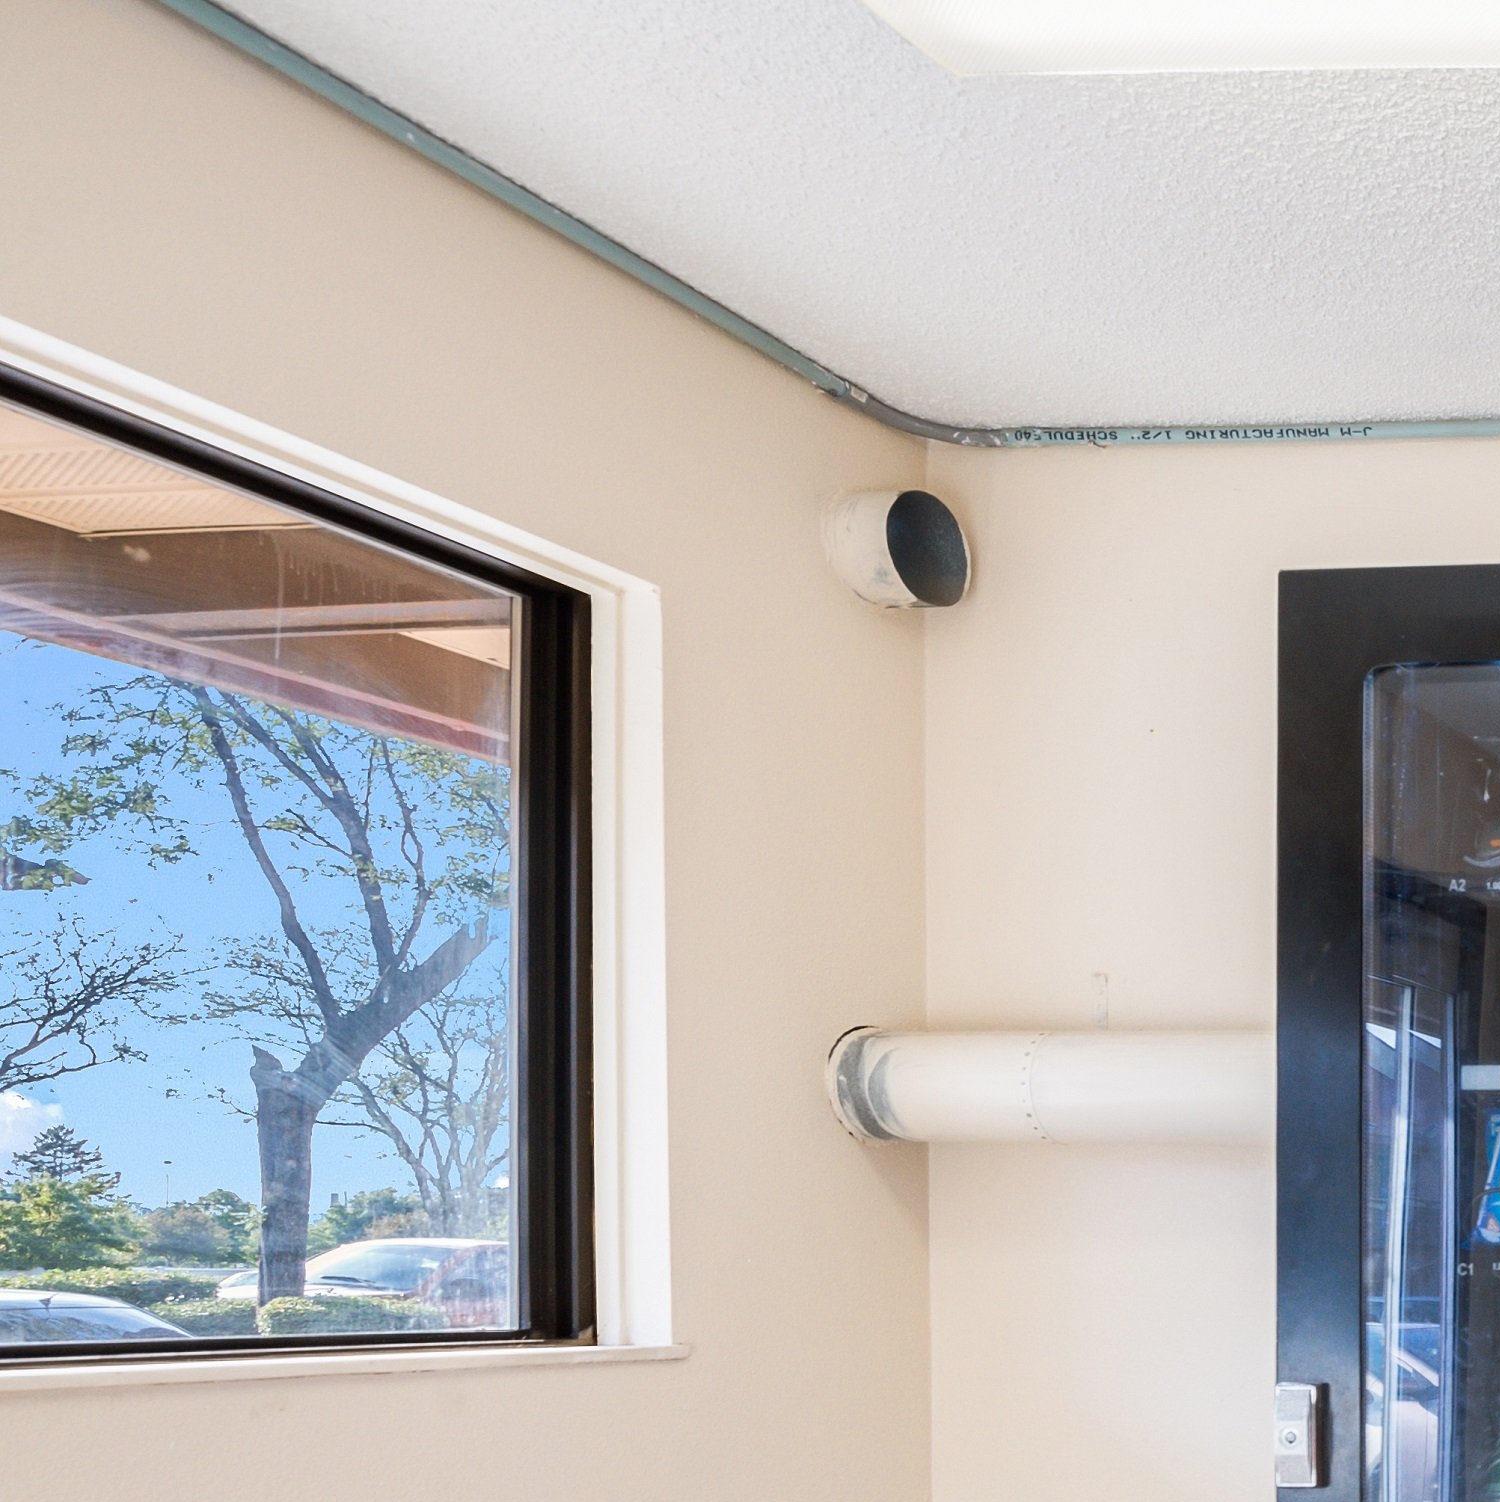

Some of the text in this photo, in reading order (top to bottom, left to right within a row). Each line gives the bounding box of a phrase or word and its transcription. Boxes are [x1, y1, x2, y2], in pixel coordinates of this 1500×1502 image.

[1185, 426, 1330, 441] MANUFACTURING
[1340, 425, 1373, 438] J-M
[1449, 878, 1467, 892] A2
